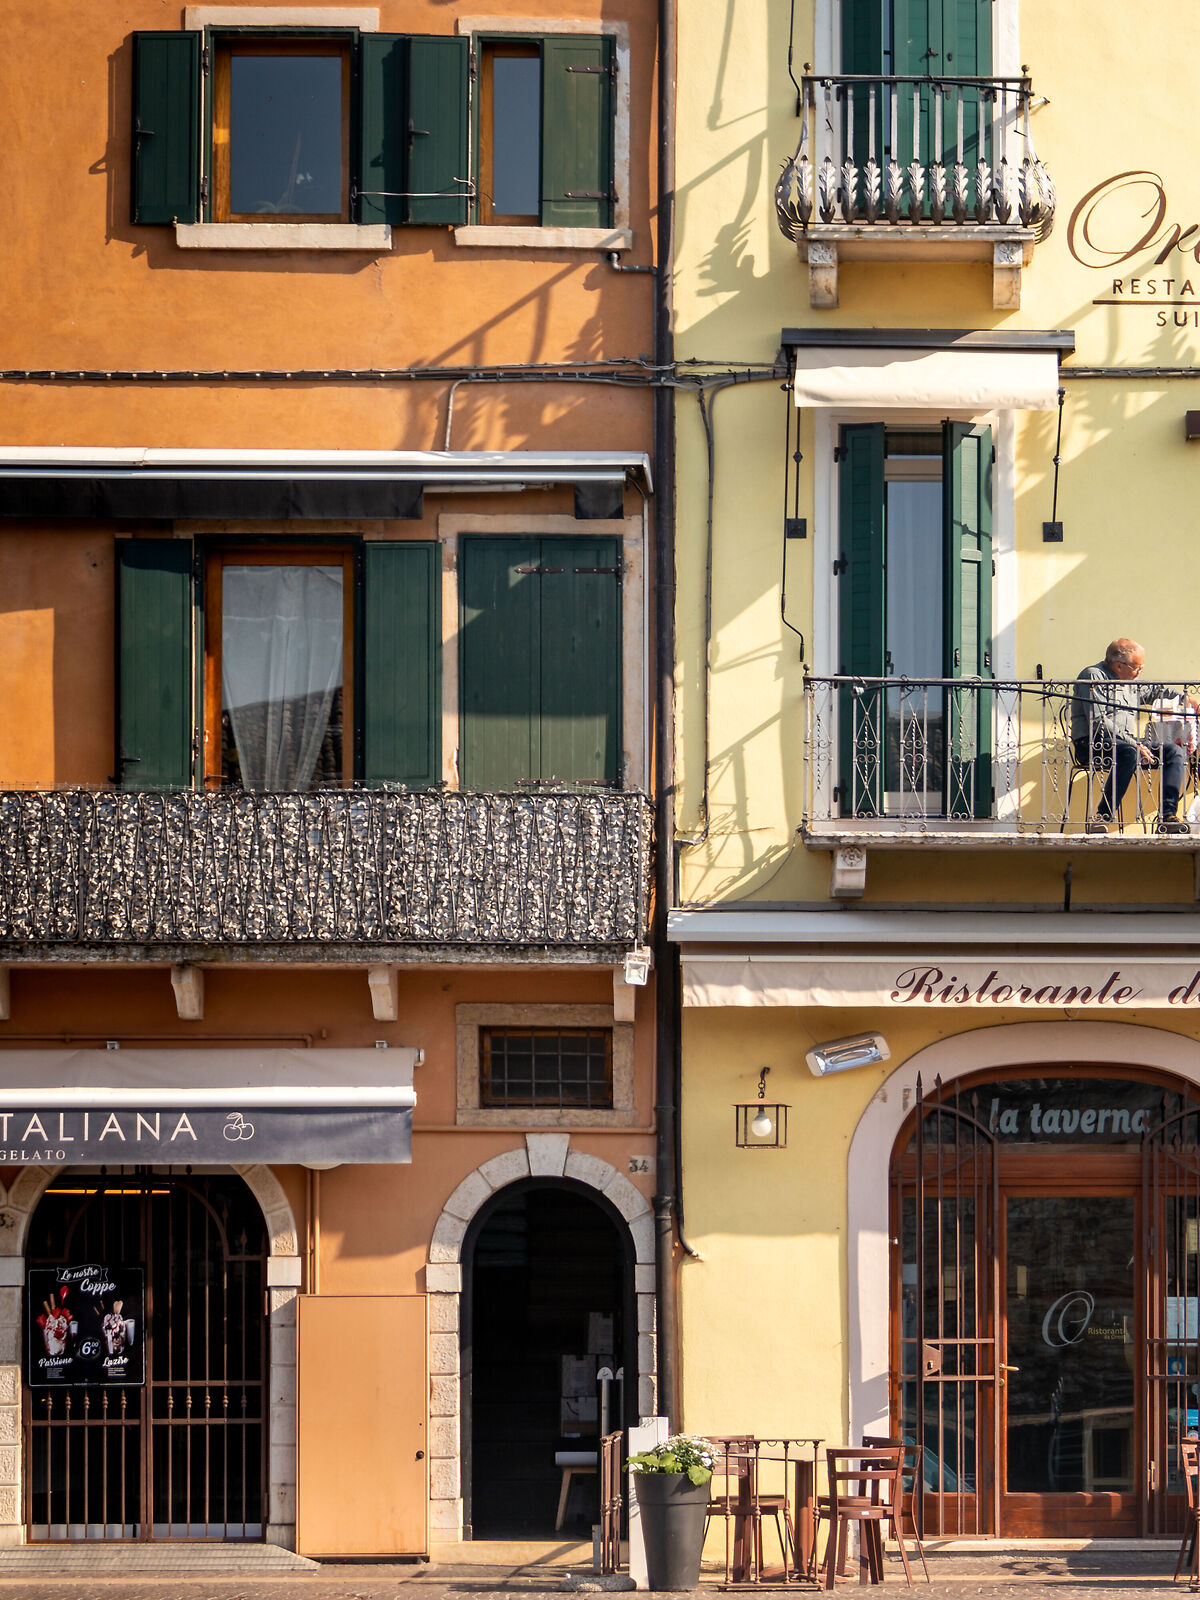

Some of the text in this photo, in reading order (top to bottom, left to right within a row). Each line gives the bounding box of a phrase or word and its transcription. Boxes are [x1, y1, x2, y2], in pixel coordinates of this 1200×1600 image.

[890, 966, 1144, 1005] Ristorante
[989, 1097, 1150, 1134] la taverna
[0, 1112, 198, 1142] TALIANA
[0, 1149, 66, 1161] GELATO
[629, 1159, 649, 1173] 34
[61, 1266, 99, 1281] Le nostre
[80, 1278, 116, 1296] Coppe
